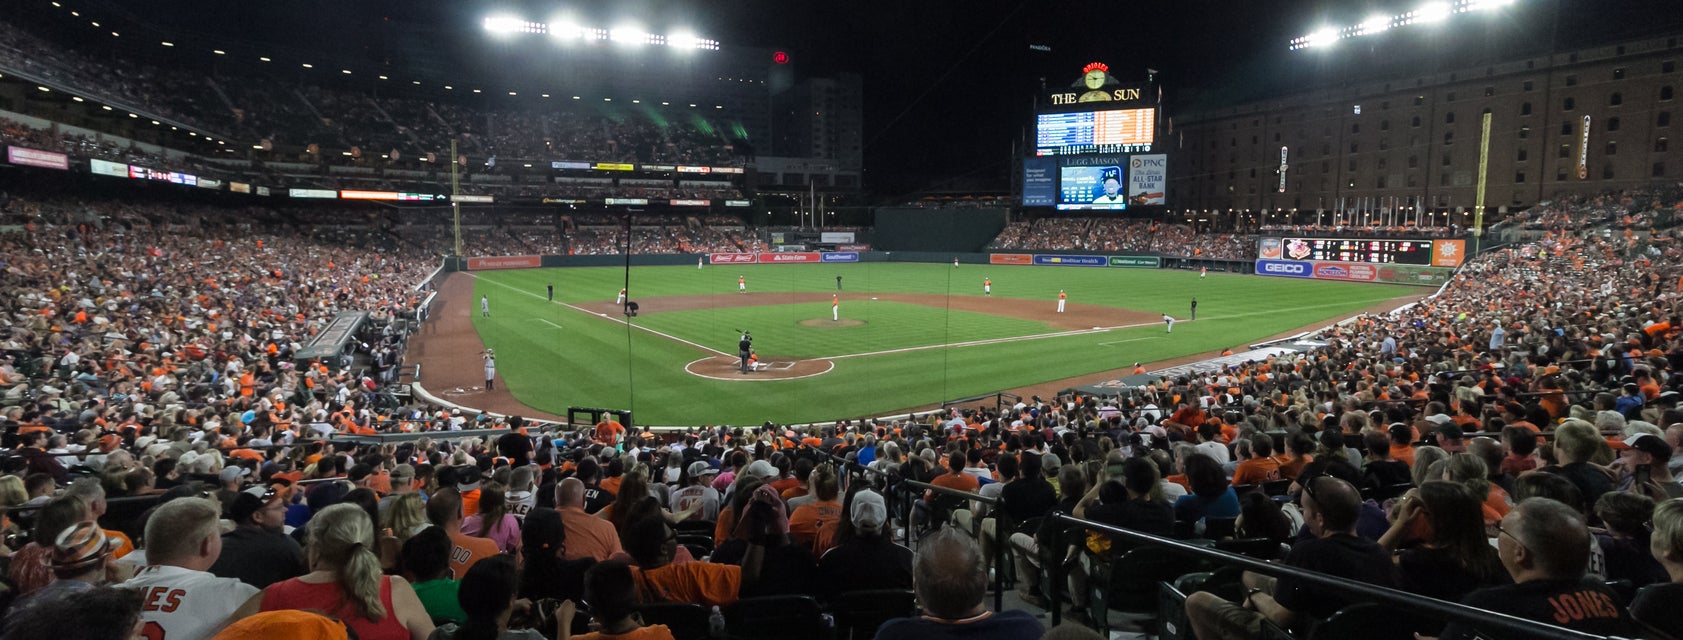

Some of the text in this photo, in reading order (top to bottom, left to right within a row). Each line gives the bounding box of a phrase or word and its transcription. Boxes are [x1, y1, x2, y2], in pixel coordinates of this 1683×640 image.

[1083, 62, 1108, 73] ORIOLES
[1051, 88, 1139, 105] THE SUN
[1090, 157, 1120, 165] MASON
[1143, 159, 1165, 167] PNC
[1133, 175, 1163, 183] ALL-STAR
[1139, 182, 1156, 190] BANK
[1265, 263, 1304, 273] GEICO
[141, 586, 187, 613] ES
[1547, 589, 1619, 624] JONES
